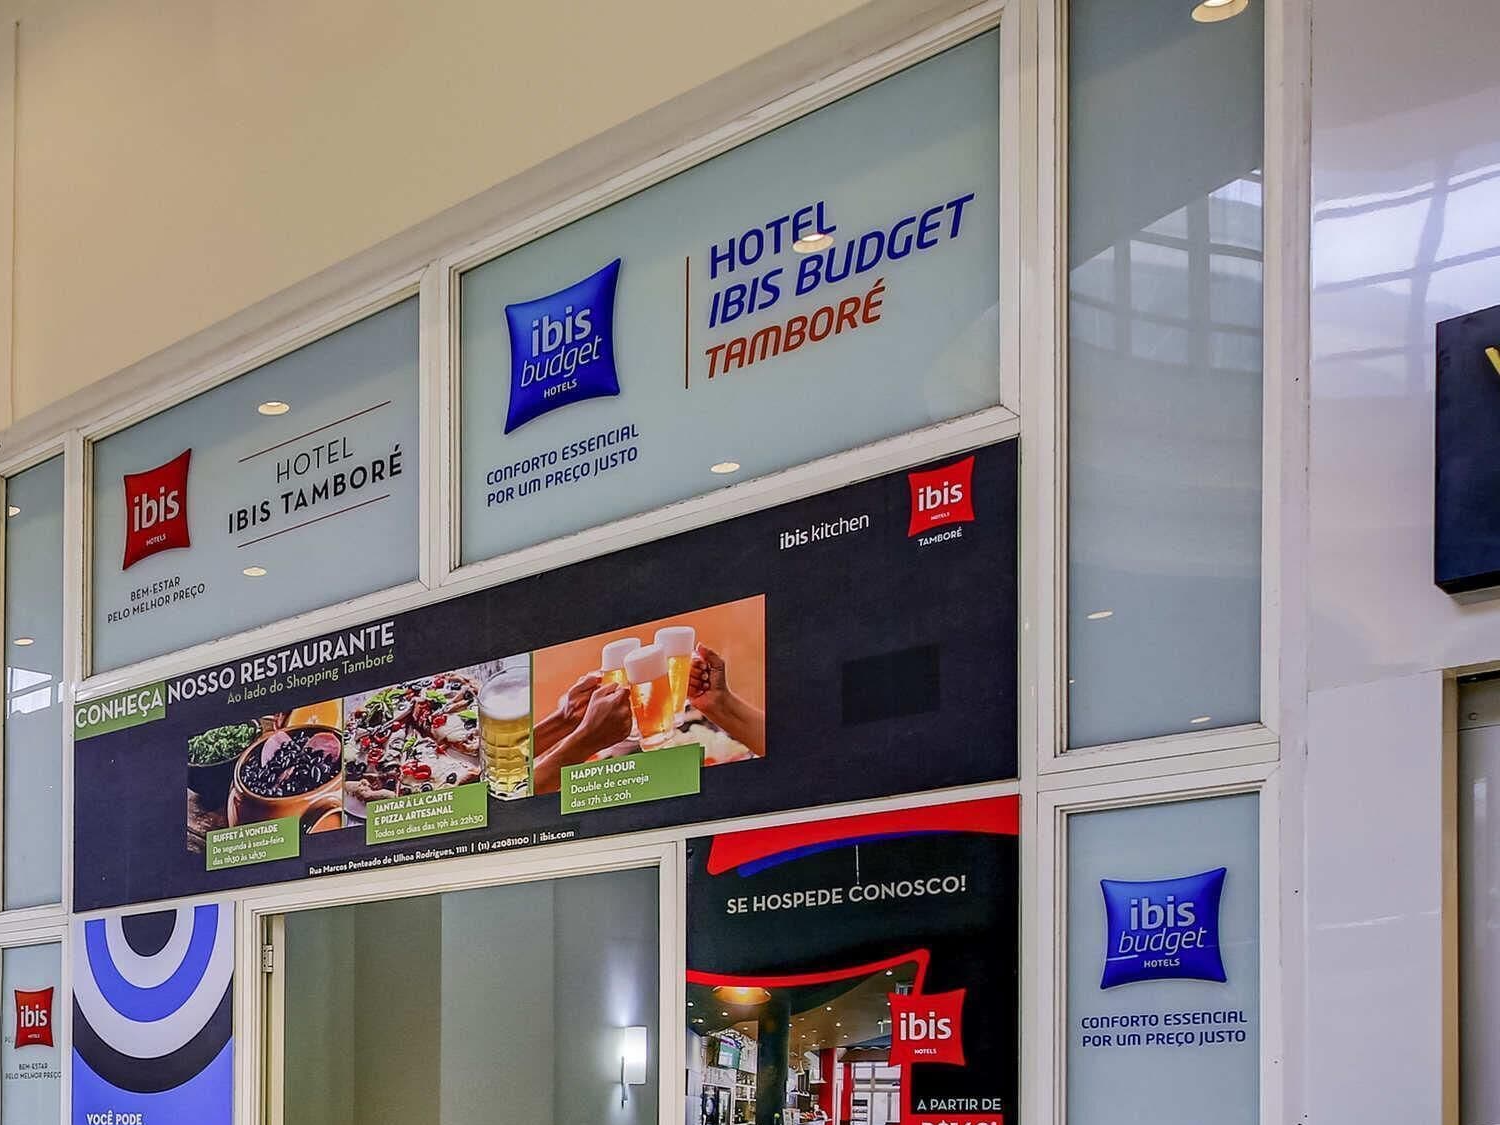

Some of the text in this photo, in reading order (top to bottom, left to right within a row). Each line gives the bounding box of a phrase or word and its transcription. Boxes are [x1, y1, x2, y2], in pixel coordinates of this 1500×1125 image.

[709, 200, 837, 280] HOTEL
[708, 192, 976, 329] IBIS BUDGET
[532, 306, 593, 358] ibis
[706, 277, 887, 379] TAMBORÉ
[520, 335, 603, 388] budget
[543, 379, 578, 399] HOTELS
[275, 436, 354, 485] HOTEL
[486, 423, 640, 486] CONFORTO ESSENCIAL
[227, 443, 403, 535] IBIS TAMBORÉ
[487, 446, 638, 507] POR UM PREÇO JUSTO
[133, 486, 180, 533] ibis
[918, 480, 964, 512] ibis
[145, 532, 167, 547] HOTELS
[779, 514, 870, 550] ibis kitchen
[917, 525, 963, 547] TAMBORÉ
[107, 582, 206, 624] PELO MELHOR PREÇO
[130, 575, 181, 601] BEM-ESTAR
[75, 620, 396, 729] CONHEÇA NOSSO RESTAURANTE
[227, 647, 395, 705] Ao lado do Shopping Tamboré
[570, 760, 637, 781] HAPPY HOUR
[571, 773, 650, 795] Double de cerveja
[373, 800, 405, 814] JANTAR
[413, 797, 424, 807] LA
[425, 791, 454, 805] CARTE
[571, 797, 586, 809] das
[588, 794, 601, 806] 17h
[613, 789, 632, 801] 20h
[374, 804, 454, 826] E PIZZA ARTESANAL
[212, 831, 238, 843] BUFFET
[308, 866, 323, 876] Rua
[322, 863, 348, 874] Marcos
[348, 857, 382, 870] Penteado
[382, 855, 392, 866] de
[393, 852, 415, 864] Ulhoa
[415, 848, 455, 861] Rodrigues,
[539, 829, 575, 842] ibis.com
[726, 874, 967, 915] SE HOSPEDE CONOSCO!
[1130, 895, 1196, 931] ibis
[1118, 926, 1207, 956] budget
[1143, 957, 1181, 969] HOTELS
[20, 1003, 48, 1028] ibis
[899, 1011, 952, 1041] ibis
[1080, 1010, 1249, 1030] CONFORTO ESSENCIAL
[1081, 1029, 1247, 1049] POR UM PREÇO JUSTO
[86, 1110, 143, 1125] VOCÊ PODE
[916, 1098, 1002, 1112] A PARTIR DE
